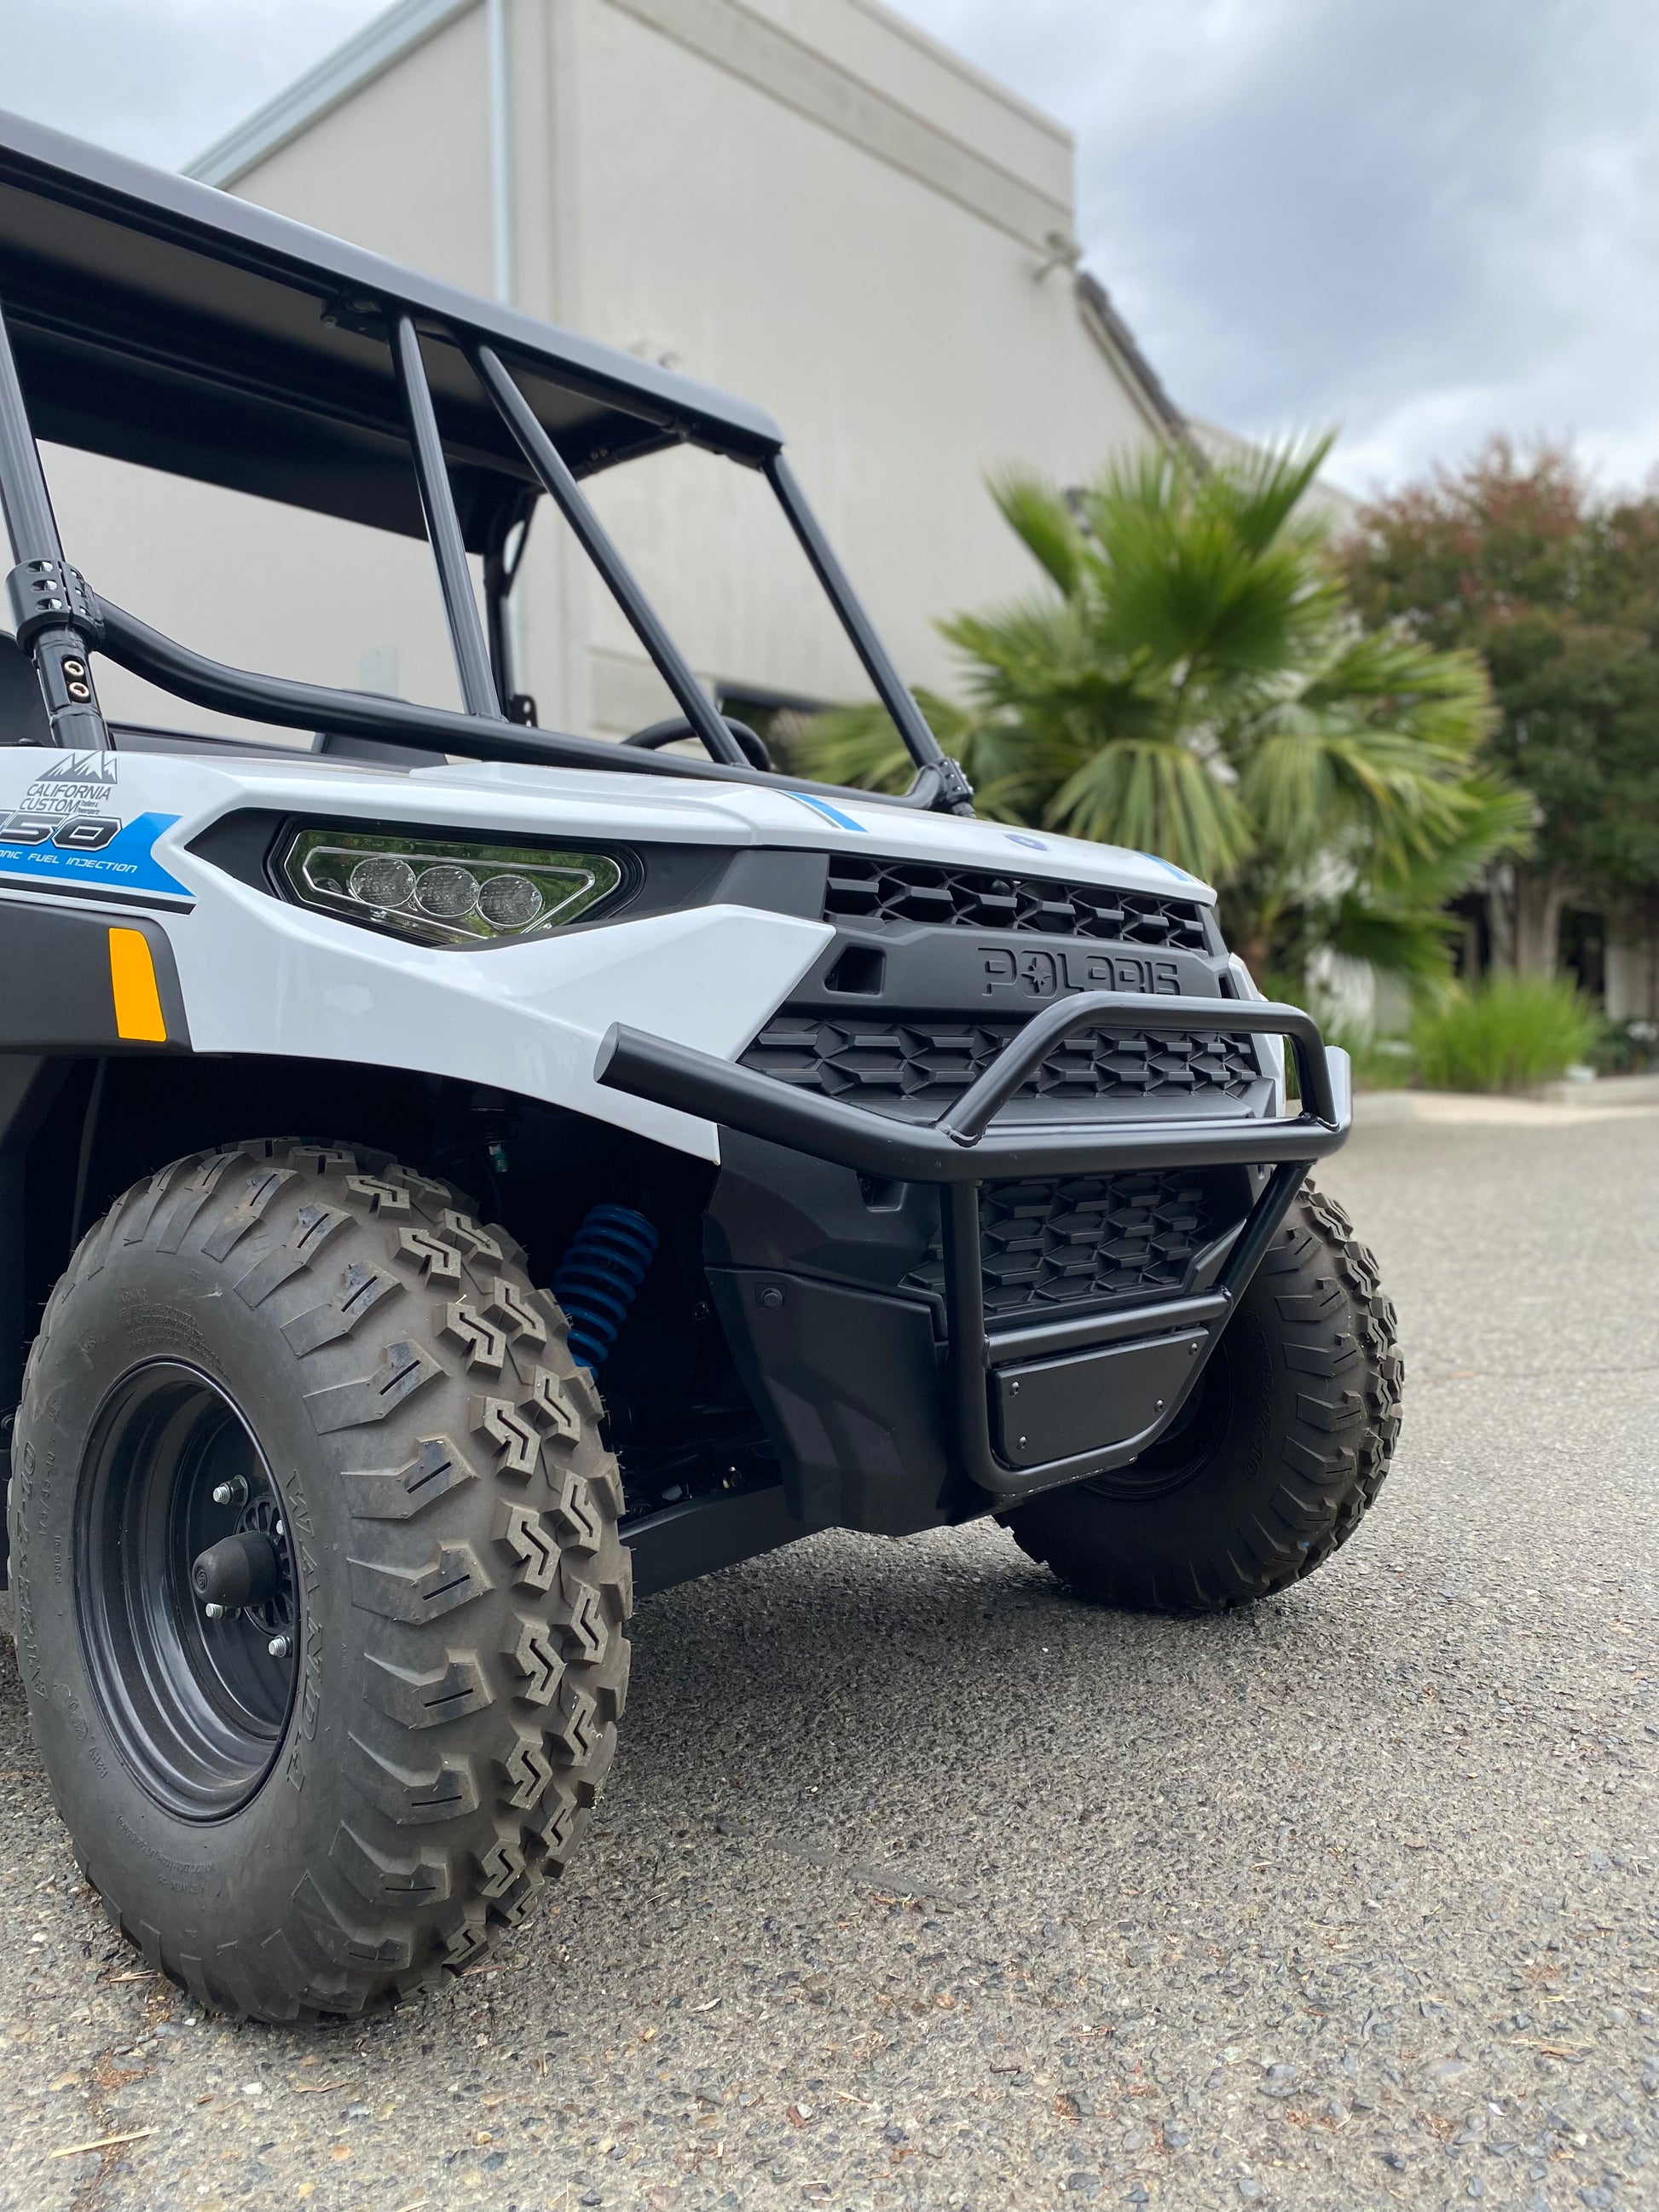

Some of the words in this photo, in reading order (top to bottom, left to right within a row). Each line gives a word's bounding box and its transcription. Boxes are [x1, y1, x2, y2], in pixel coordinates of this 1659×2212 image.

[26, 783, 112, 800] CALIFORNIA
[20, 798, 81, 813] CUSTOM
[27, 852, 60, 864] FUEL
[66, 857, 138, 874] INJECTION
[977, 947, 1182, 1000] POLARIS
[286, 1468, 323, 1792] WANDA
